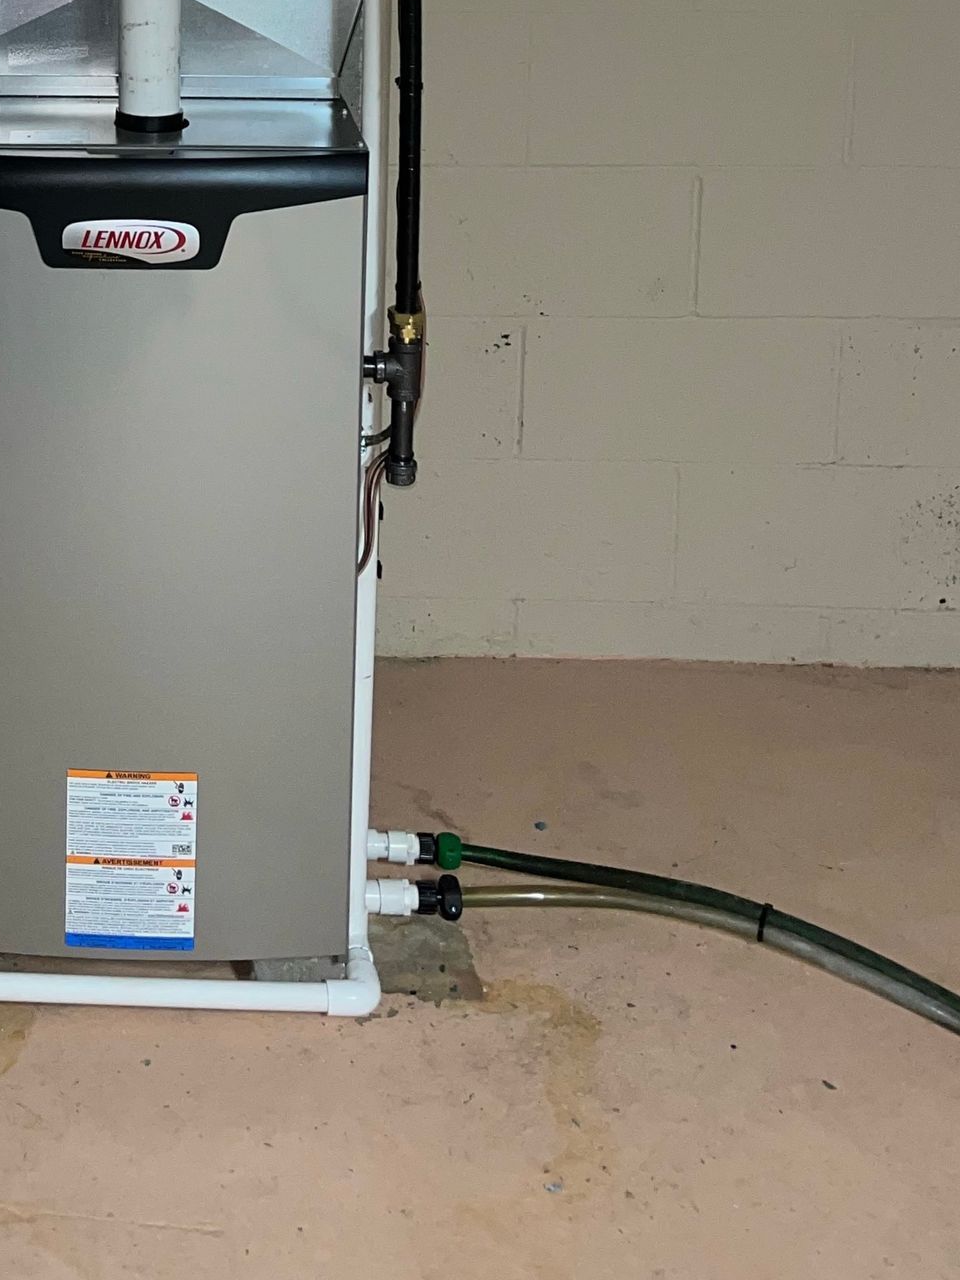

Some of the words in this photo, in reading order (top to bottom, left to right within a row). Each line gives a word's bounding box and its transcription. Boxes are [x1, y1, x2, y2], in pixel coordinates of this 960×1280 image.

[81, 230, 165, 250] LENNOX
[115, 772, 151, 780] WARNING
[101, 858, 163, 867] AVERTISSEMENT
